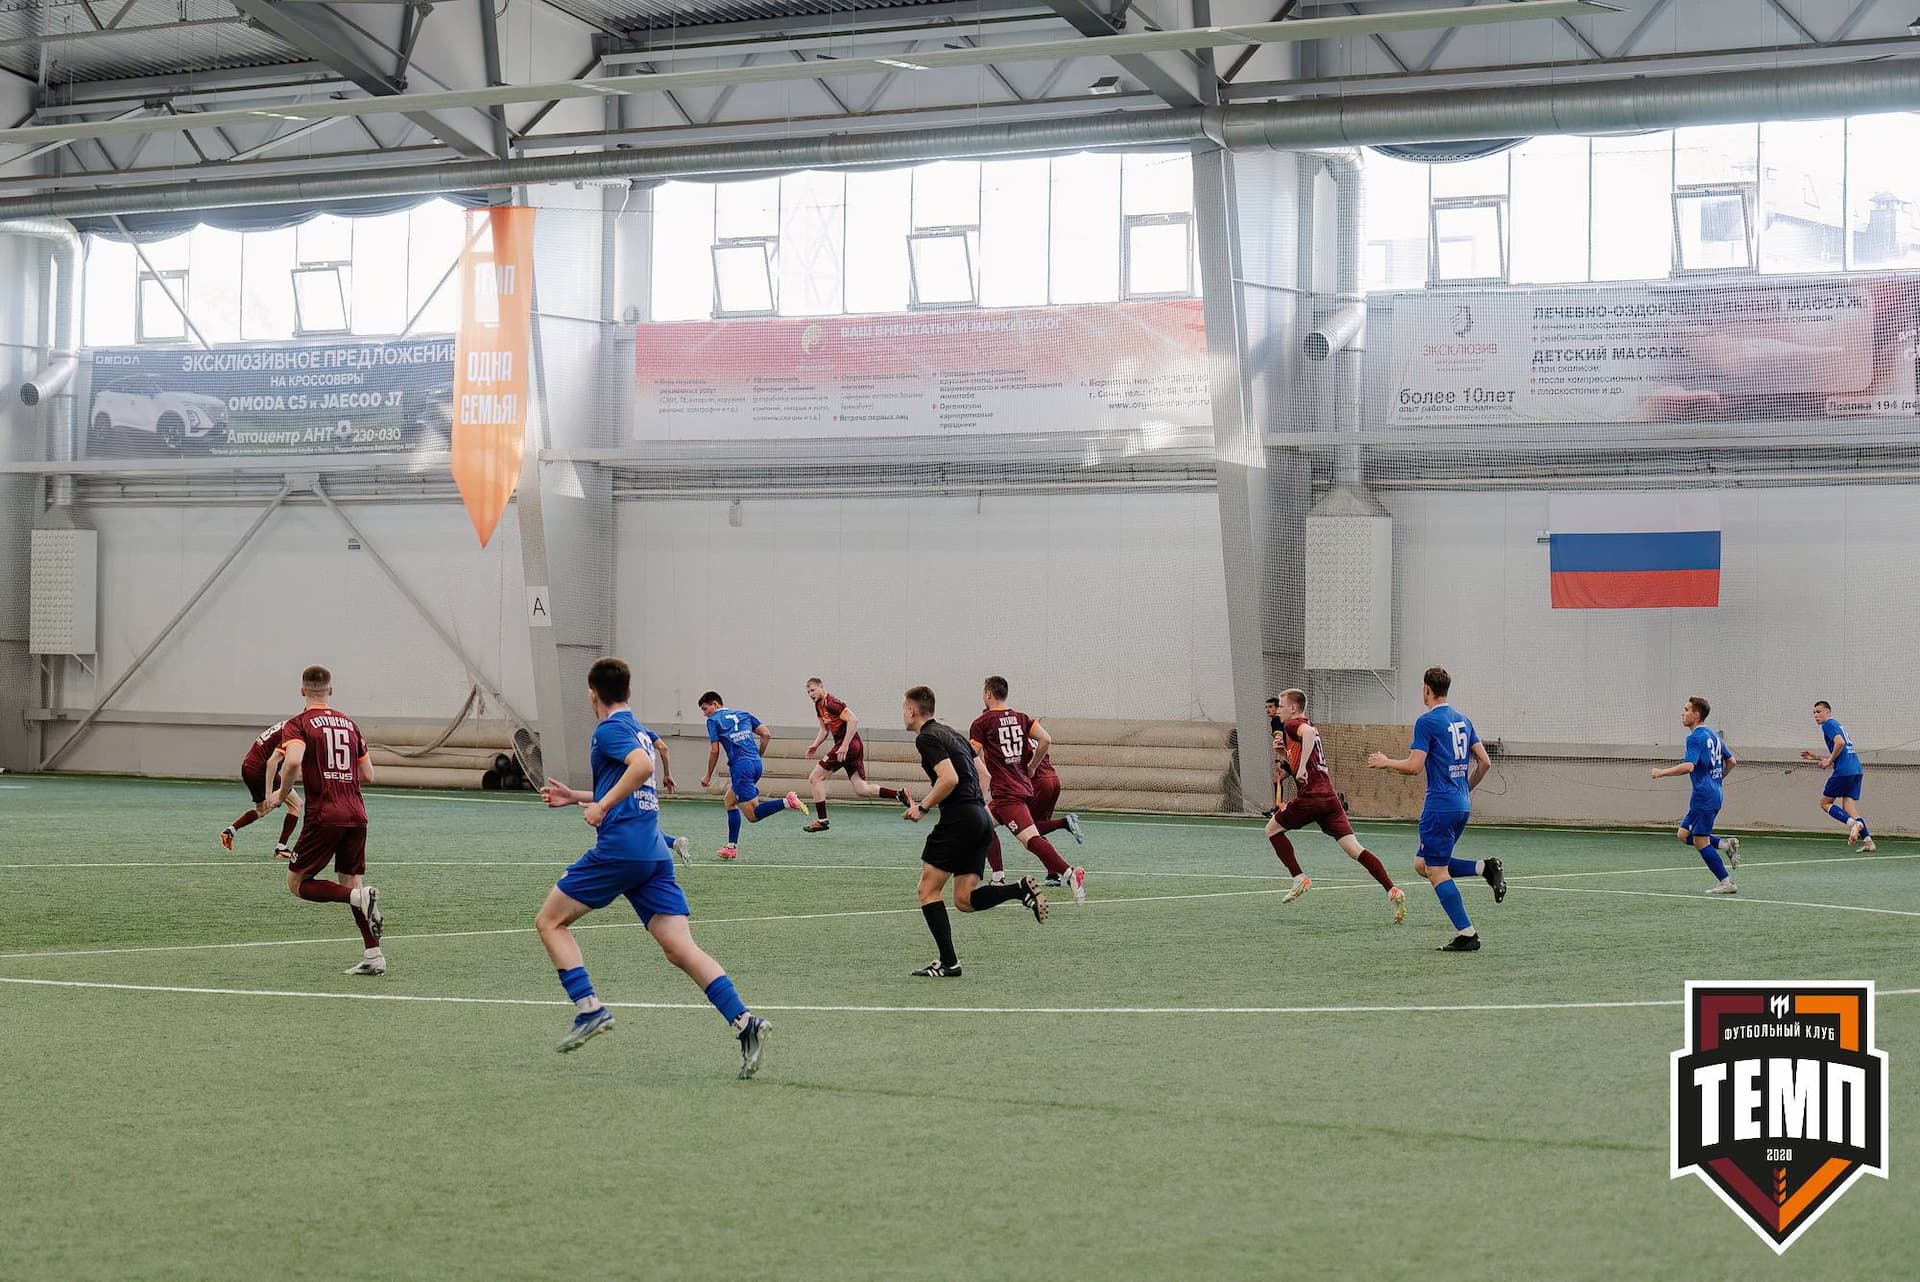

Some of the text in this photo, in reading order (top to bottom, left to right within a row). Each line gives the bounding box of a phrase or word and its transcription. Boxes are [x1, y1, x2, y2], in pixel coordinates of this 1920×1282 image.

[841, 326, 873, 338] ВАШ
[1423, 343, 1497, 356] ЭКСКЛЮЗИВ
[1532, 345, 1607, 365] ДЕТСКИЙ
[182, 350, 321, 373] ЭКСКЛЮЗИВНОЕ
[467, 351, 513, 386] ОДНА
[270, 372, 365, 388] НА КРОССОВЕРЫ
[1538, 376, 1565, 384] после
[228, 396, 285, 411] OMODA
[288, 394, 307, 410] C5
[319, 392, 381, 409] JAECOO
[384, 391, 403, 407] J7
[1400, 388, 1456, 405] более
[460, 393, 519, 425] СЕМЬЯ!
[1398, 405, 1420, 414] опыт
[303, 427, 335, 443] АНТ
[352, 427, 403, 443] 230-030
[725, 714, 740, 732] 7
[322, 726, 351, 771] 15
[998, 725, 1024, 758] 55
[1448, 721, 1468, 760] 15
[1707, 737, 1722, 767] 34
